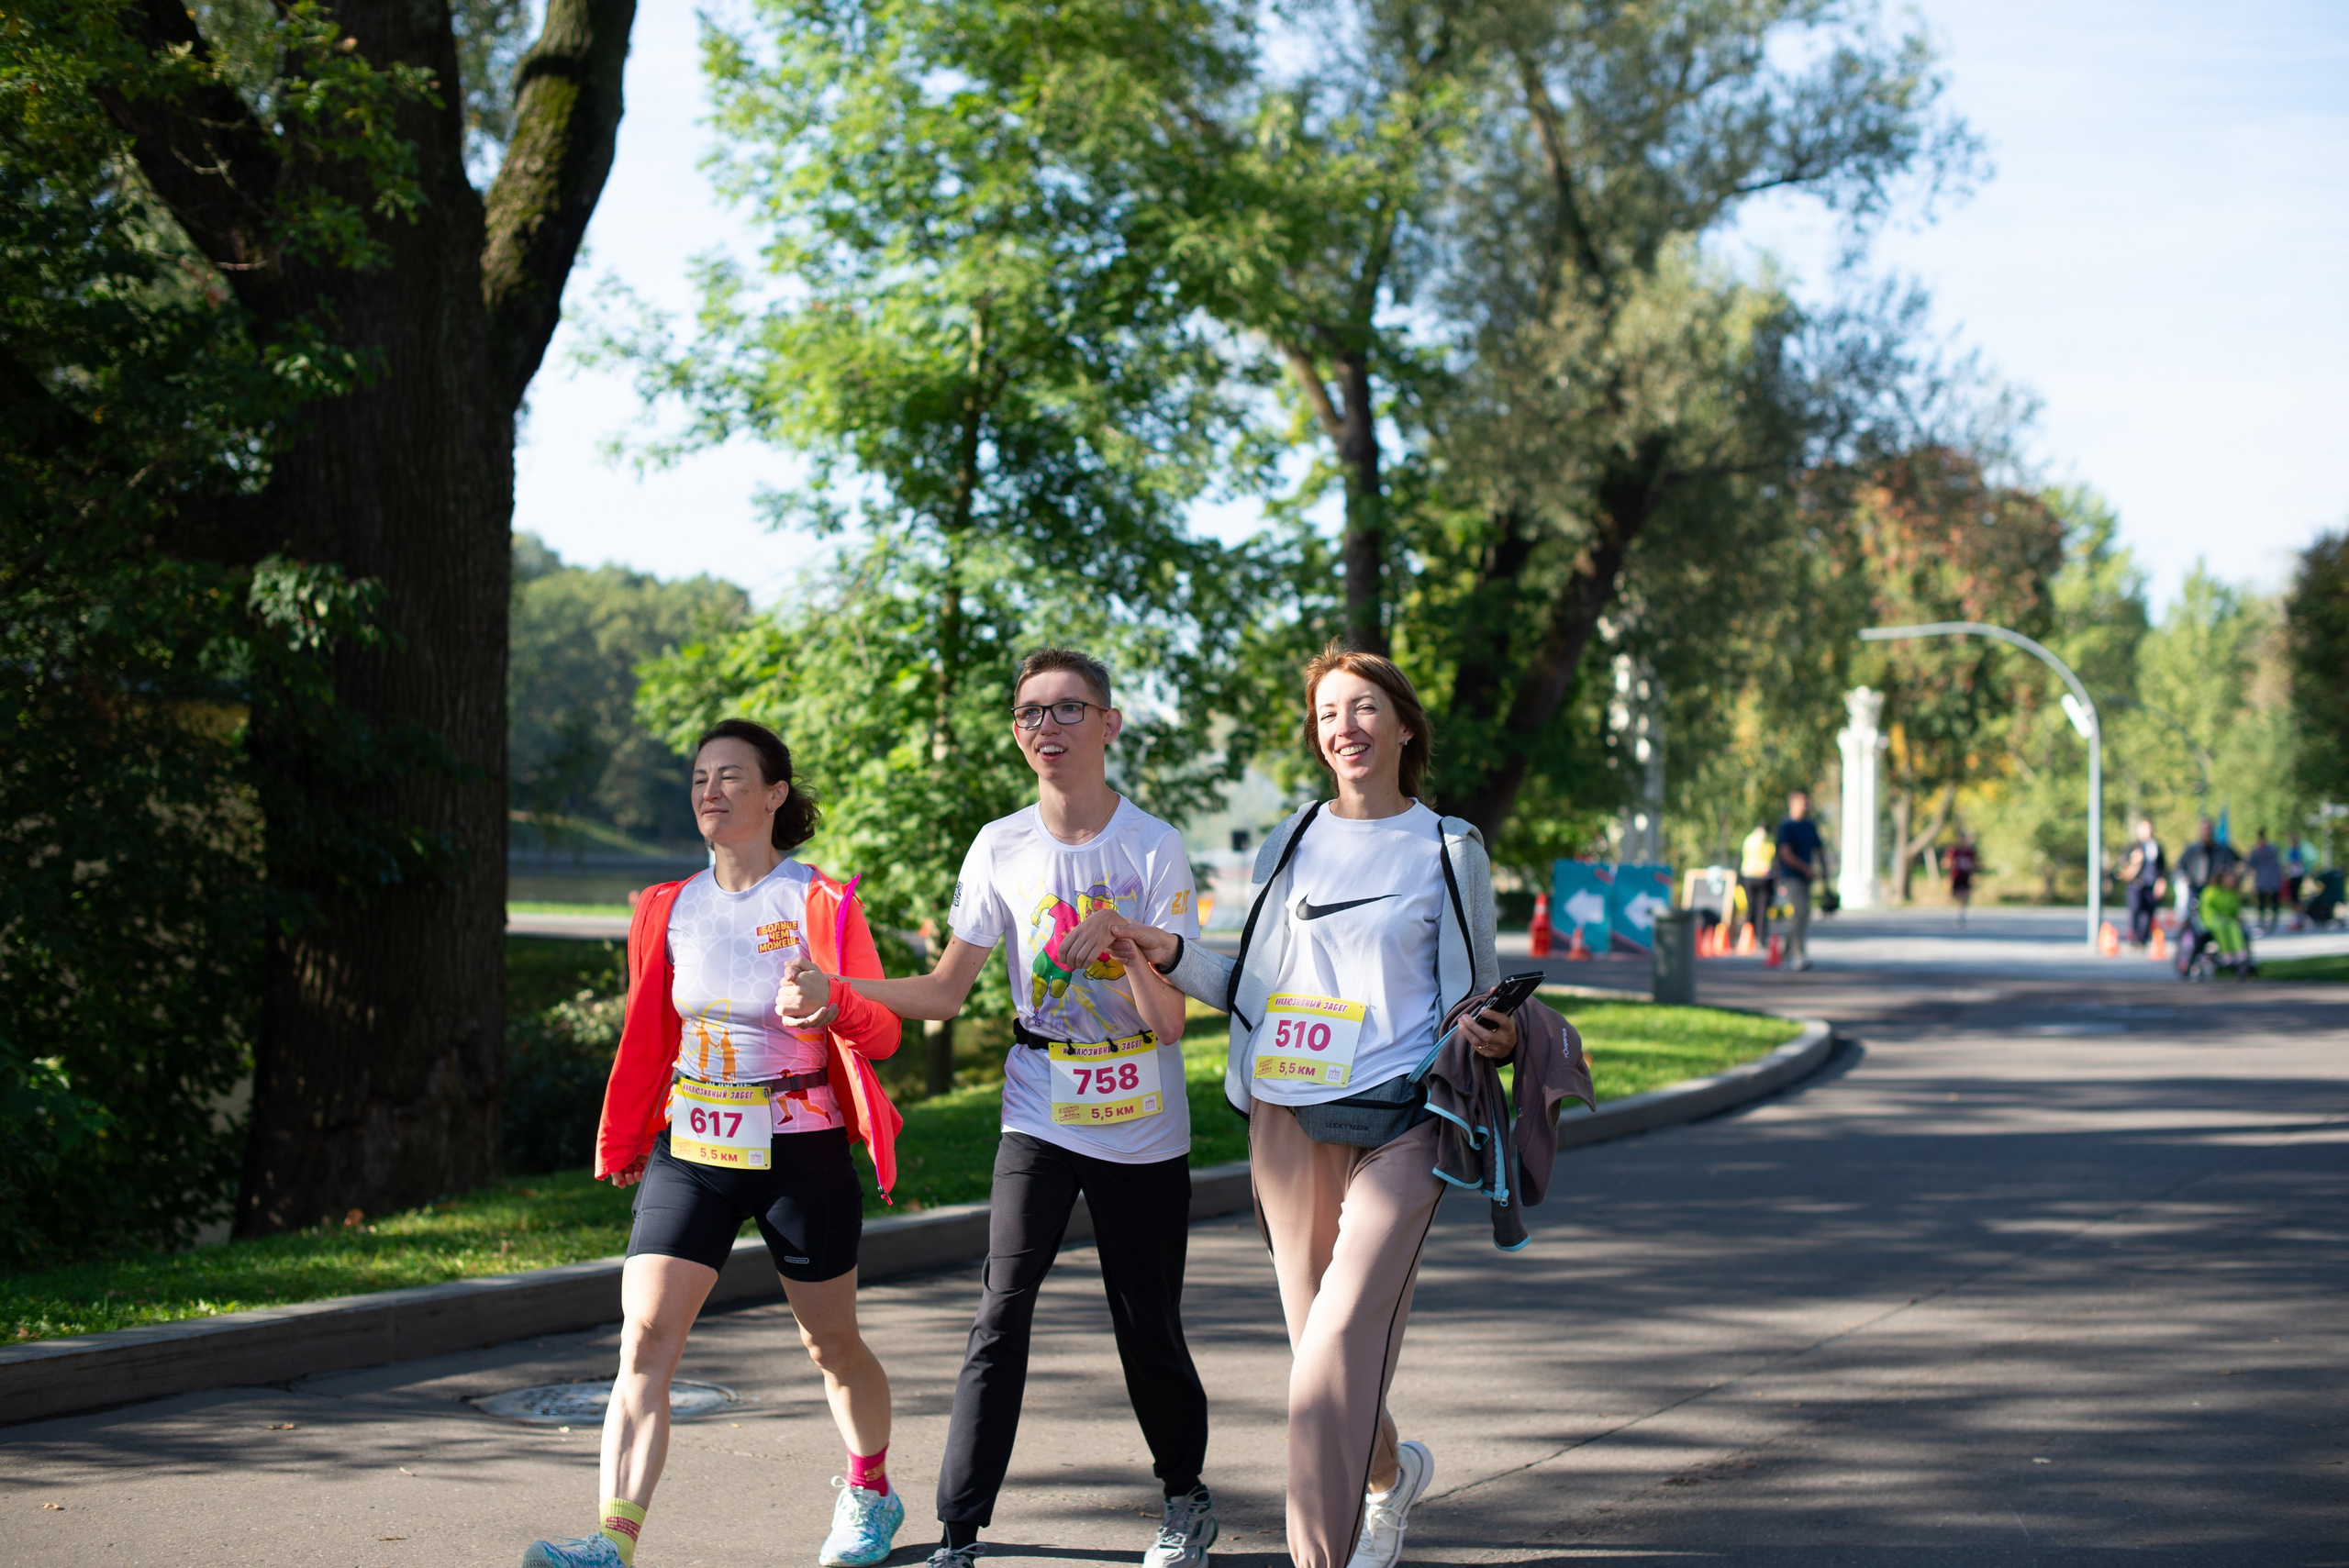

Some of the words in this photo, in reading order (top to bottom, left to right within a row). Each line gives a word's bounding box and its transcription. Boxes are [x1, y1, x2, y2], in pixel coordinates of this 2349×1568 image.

[760, 920, 798, 935] БОЛЬШЕ
[769, 929, 789, 940] ЧЕМ
[1275, 997, 1321, 1008] ИНКЛЮЗИВНЫЙ
[1323, 1002, 1348, 1013] ЗАБЕГ
[1275, 1019, 1331, 1051] 510
[1121, 1039, 1143, 1051] ЗАБЕГ
[1279, 1062, 1296, 1076] 5,5
[1073, 1062, 1140, 1095] 758
[683, 1084, 728, 1099] ИНКЛЮЗИВНЫЙ
[730, 1090, 754, 1100] ЗАБЕГ
[1091, 1106, 1113, 1121] 5,5
[690, 1107, 742, 1139] 617
[1326, 1121, 1349, 1129] LUCKY
[700, 1147, 718, 1161] 5,5
